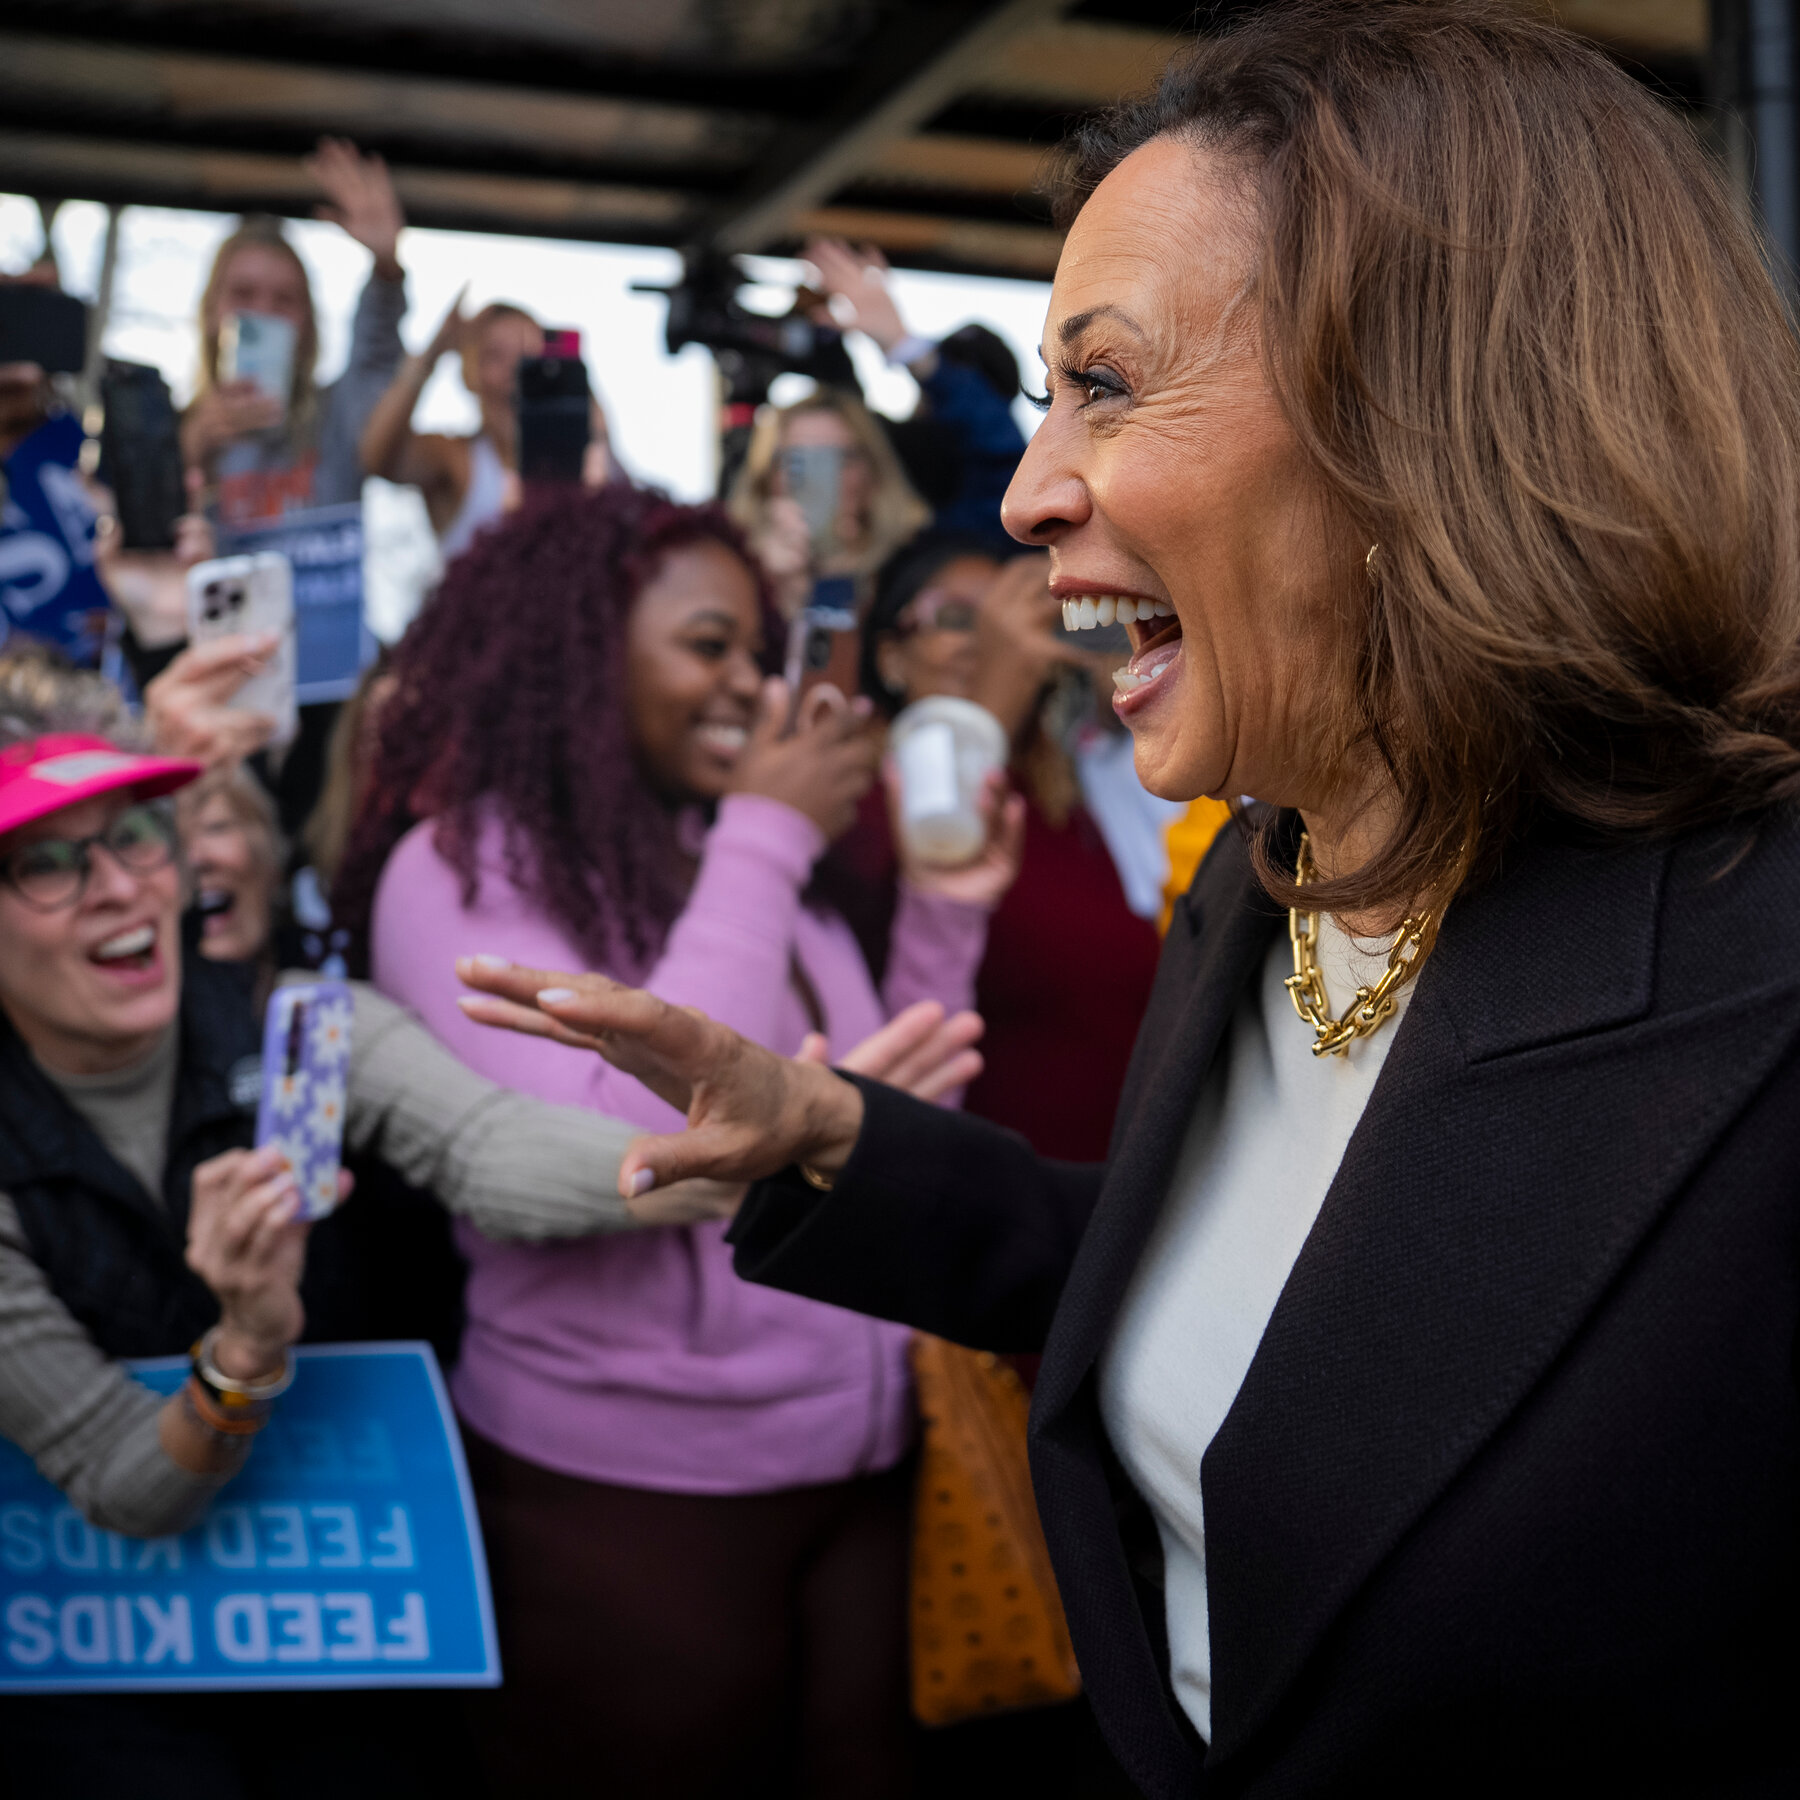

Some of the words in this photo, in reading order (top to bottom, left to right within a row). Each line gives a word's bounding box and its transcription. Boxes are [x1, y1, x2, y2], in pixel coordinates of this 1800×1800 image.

[208, 1506, 414, 1569] FEED
[6, 1594, 194, 1665] KIDS
[214, 1592, 430, 1663] FEED
